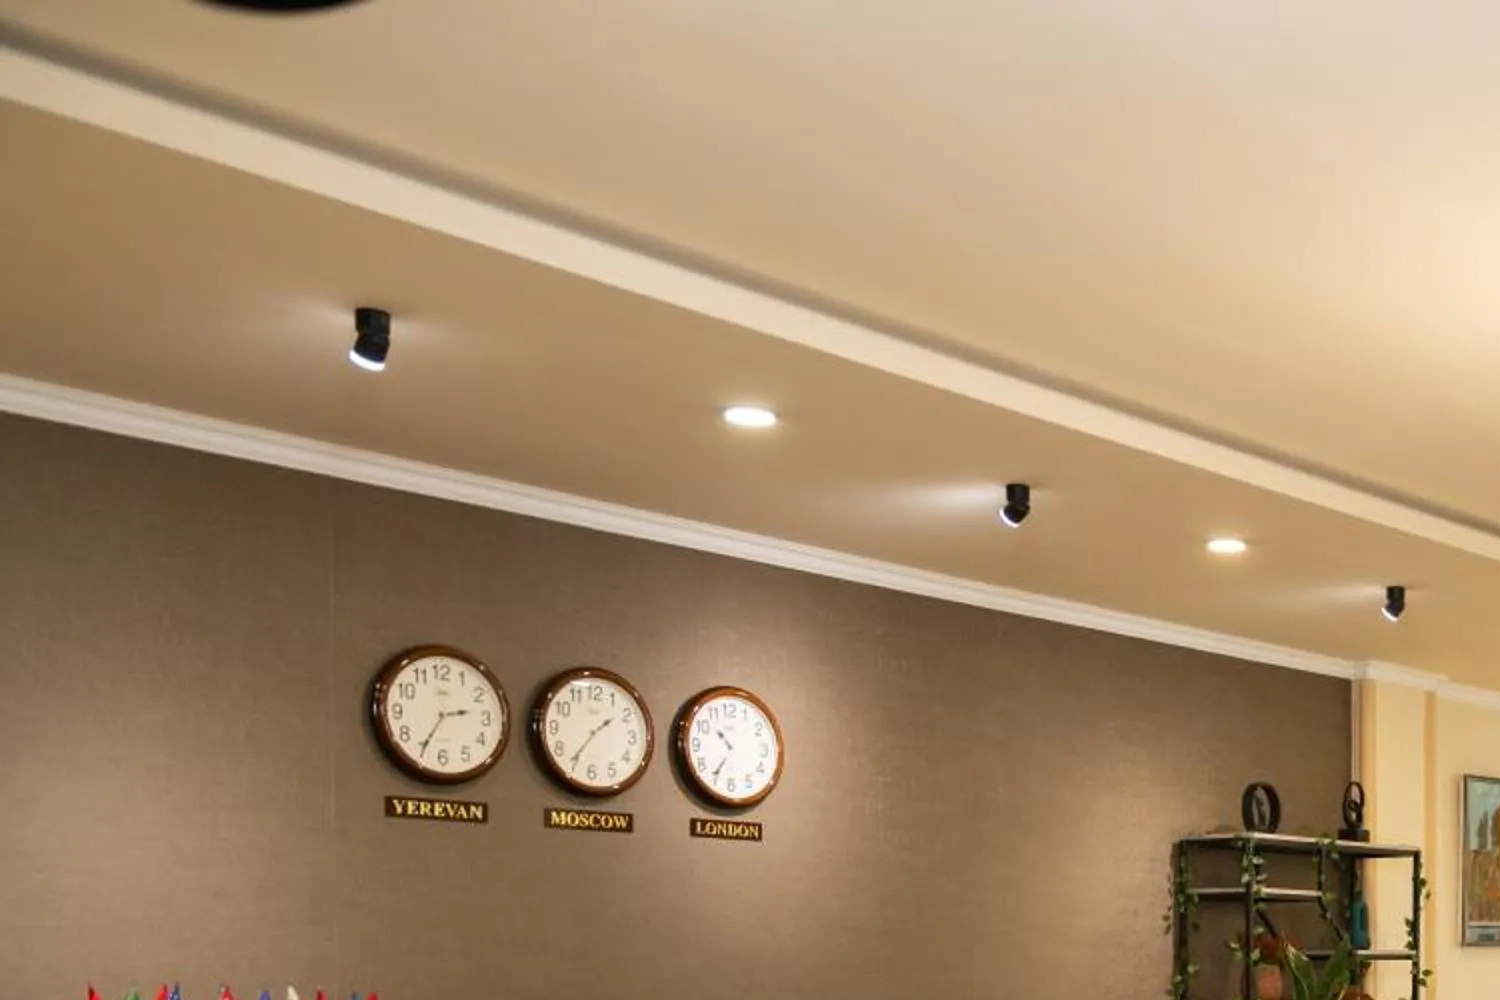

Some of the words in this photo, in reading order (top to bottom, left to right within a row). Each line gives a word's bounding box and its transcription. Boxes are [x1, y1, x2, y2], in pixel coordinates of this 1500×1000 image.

[414, 667, 427, 685] 11
[433, 664, 451, 682] 12
[458, 671, 465, 687] 1
[399, 682, 416, 700] 10
[473, 687, 485, 703] 2
[569, 688, 582, 704] 11
[587, 685, 604, 701] 12
[609, 692, 615, 706] 1
[391, 703, 403, 720] 9
[556, 701, 571, 717] 10
[622, 707, 632, 723] 2
[481, 710, 491, 727] 3
[400, 725, 411, 742] 8
[549, 720, 559, 735] 9
[476, 732, 486, 746] 4
[627, 730, 637, 746] 3
[437, 749, 449, 766] 6
[461, 745, 471, 762] 5
[586, 764, 598, 780] 6
[607, 762, 616, 777] 5
[392, 799, 484, 820] YEREVAN
[550, 810, 630, 829] MOSCOW
[696, 821, 760, 839] LONDON
